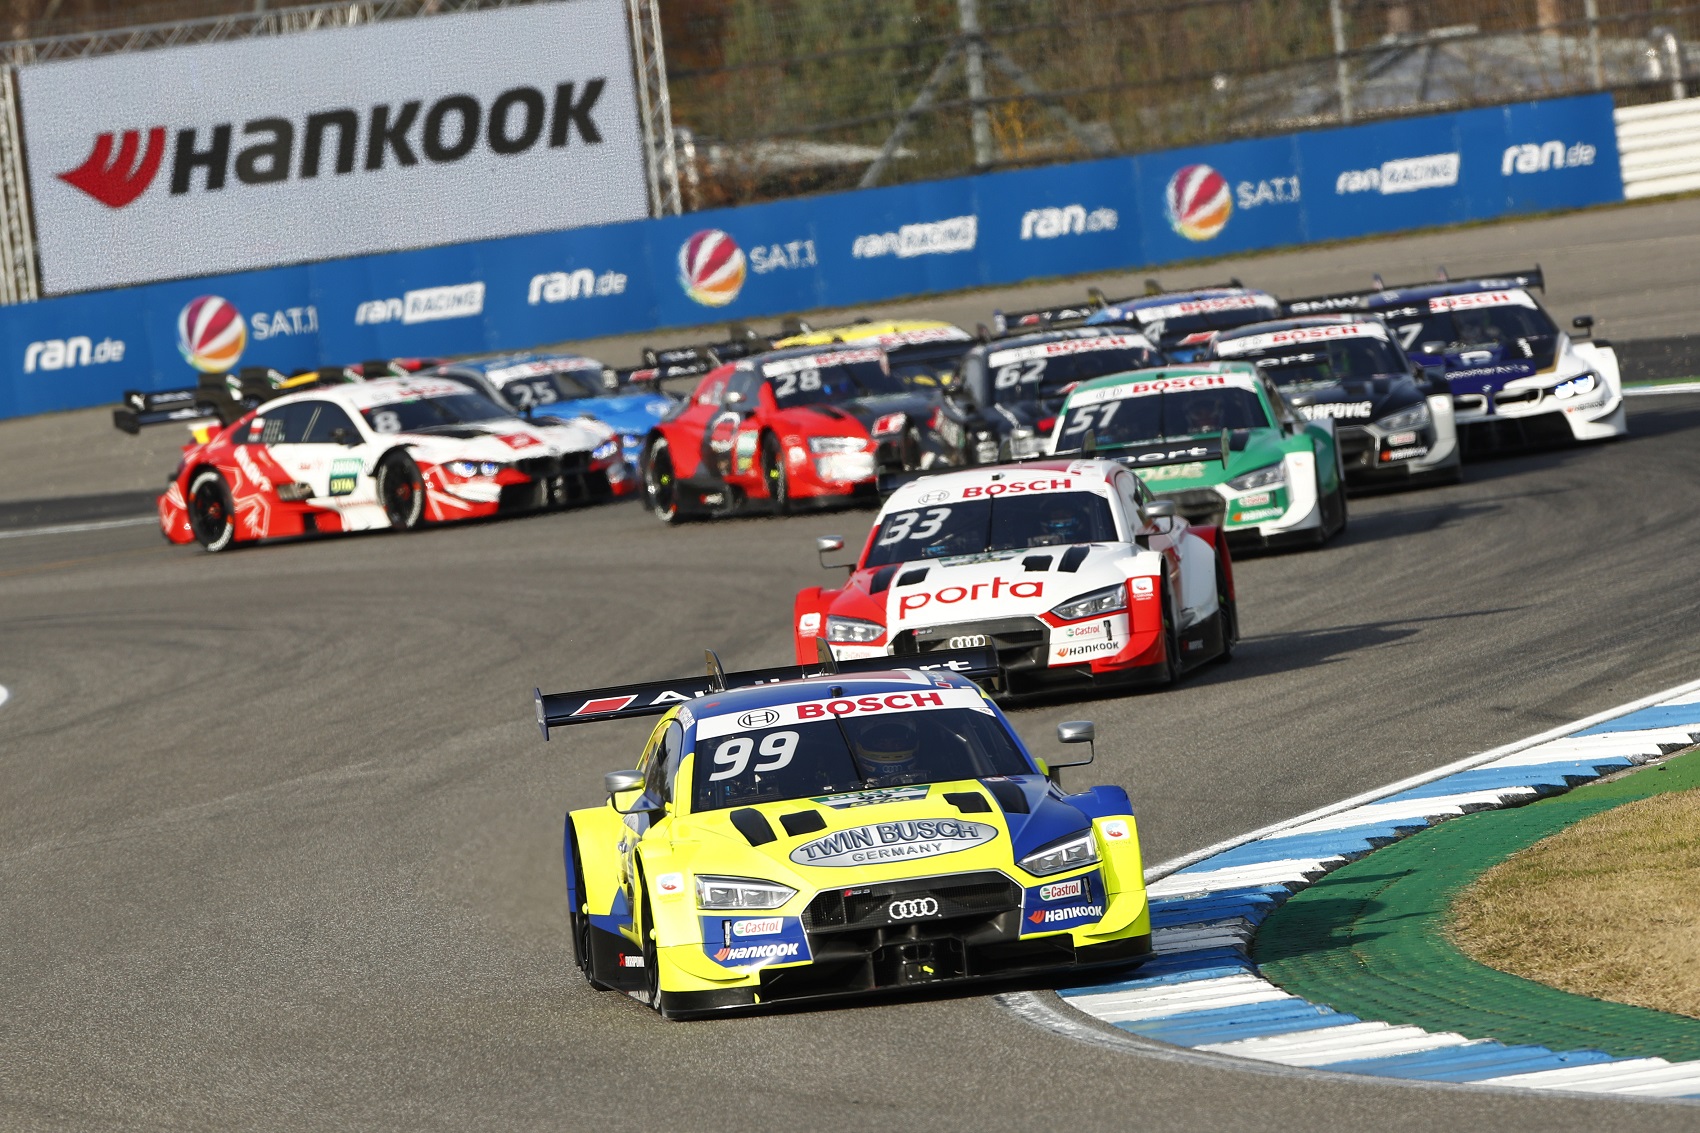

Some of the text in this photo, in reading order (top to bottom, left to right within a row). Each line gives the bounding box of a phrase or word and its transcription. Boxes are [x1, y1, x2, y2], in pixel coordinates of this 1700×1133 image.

[1502, 139, 1596, 176] ran.de
[1336, 159, 1454, 195] ran RACING
[1020, 203, 1119, 241] ran.de
[852, 232, 899, 260] ran
[528, 268, 628, 306] ran.de
[355, 297, 404, 326] ran
[1180, 296, 1257, 314] BOSCH
[1046, 335, 1127, 355] BOSCH
[1272, 325, 1359, 343] BOSCH
[23, 335, 126, 374] ran.de
[776, 368, 823, 399] 28
[995, 358, 1048, 390] 62
[1131, 375, 1226, 395] BOSCH
[510, 381, 558, 407] 25
[373, 411, 401, 434] 8
[1065, 400, 1122, 436] 51
[962, 478, 1072, 499] BOSCH
[878, 507, 952, 546] 33
[899, 576, 1044, 620] porta
[1074, 625, 1100, 636] Castrol
[796, 692, 944, 719] BOSCH
[708, 730, 800, 782] 99
[799, 819, 980, 859] TWIN BUSCH
[852, 842, 943, 862] GERMANY
[1051, 882, 1079, 898] Castrol
[745, 919, 779, 934] Castrol
